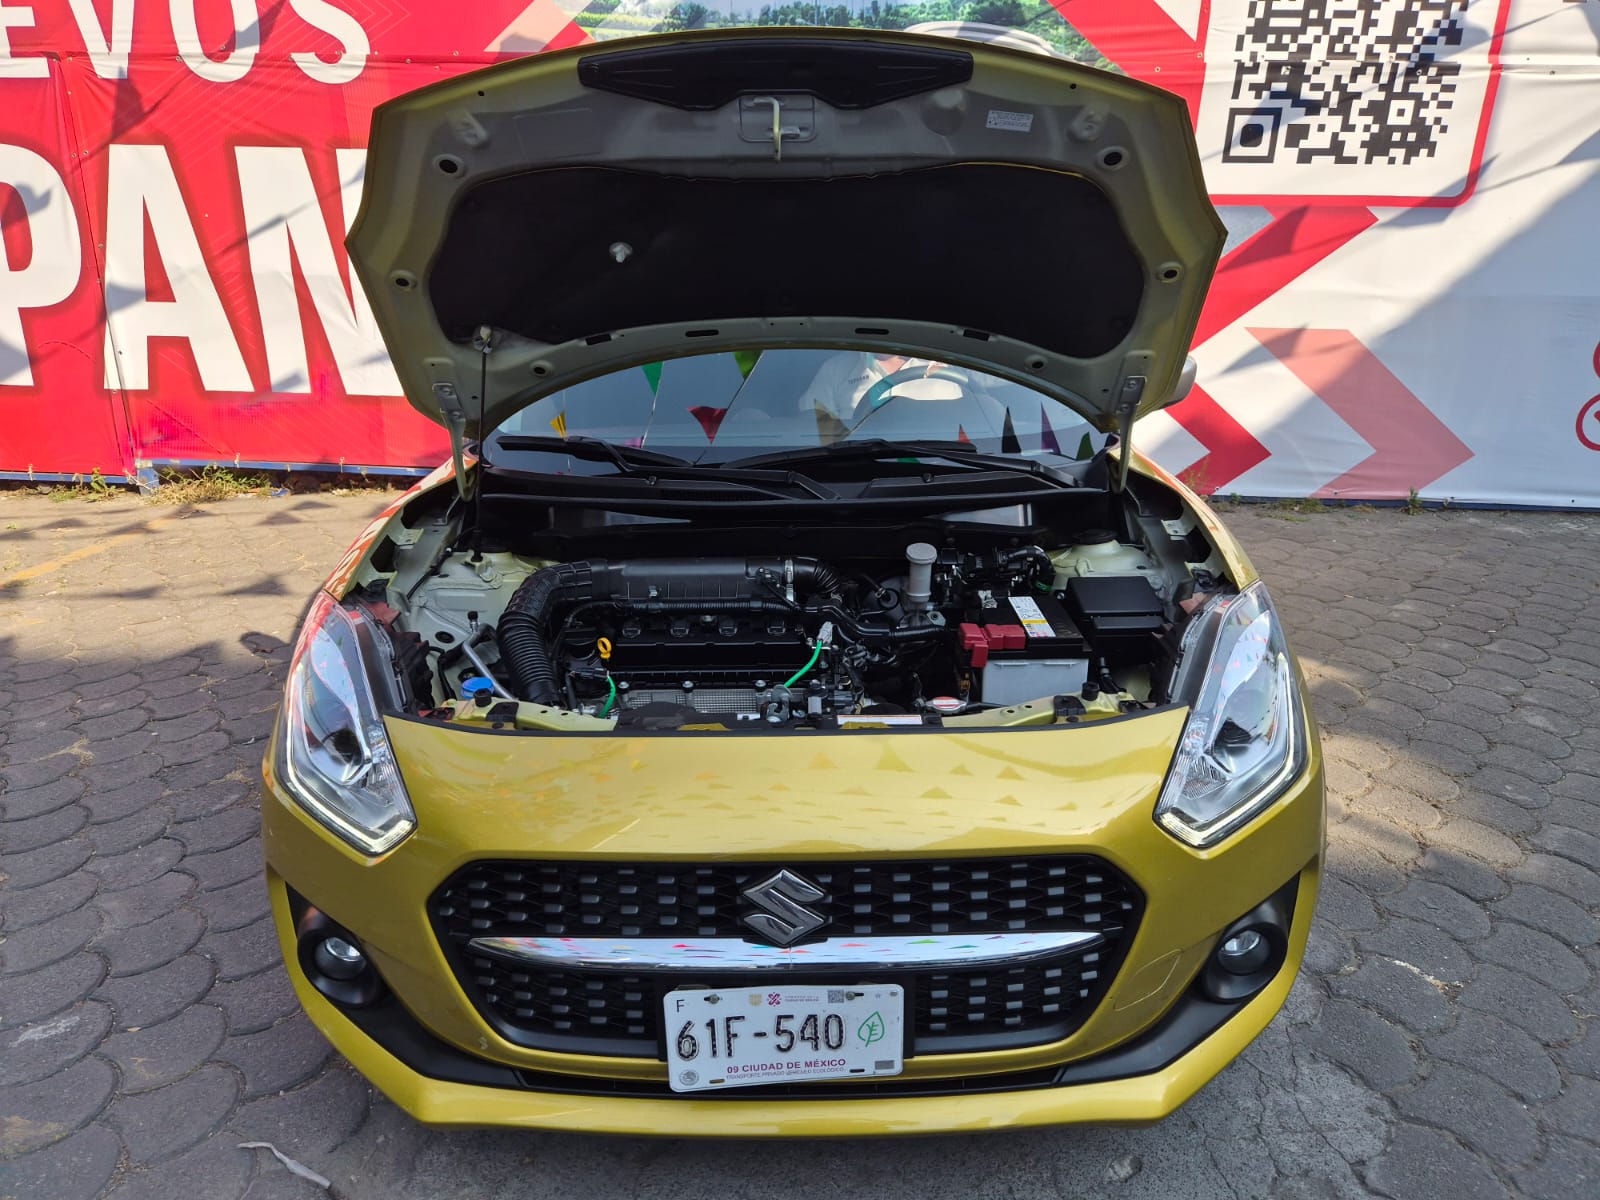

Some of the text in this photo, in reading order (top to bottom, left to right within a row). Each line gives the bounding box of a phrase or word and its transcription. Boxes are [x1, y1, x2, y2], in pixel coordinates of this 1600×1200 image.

[676, 999, 685, 1013] F
[677, 1014, 844, 1060] 61F-540
[726, 1058, 846, 1074] 09 CIUDAD DE MÉXICO
